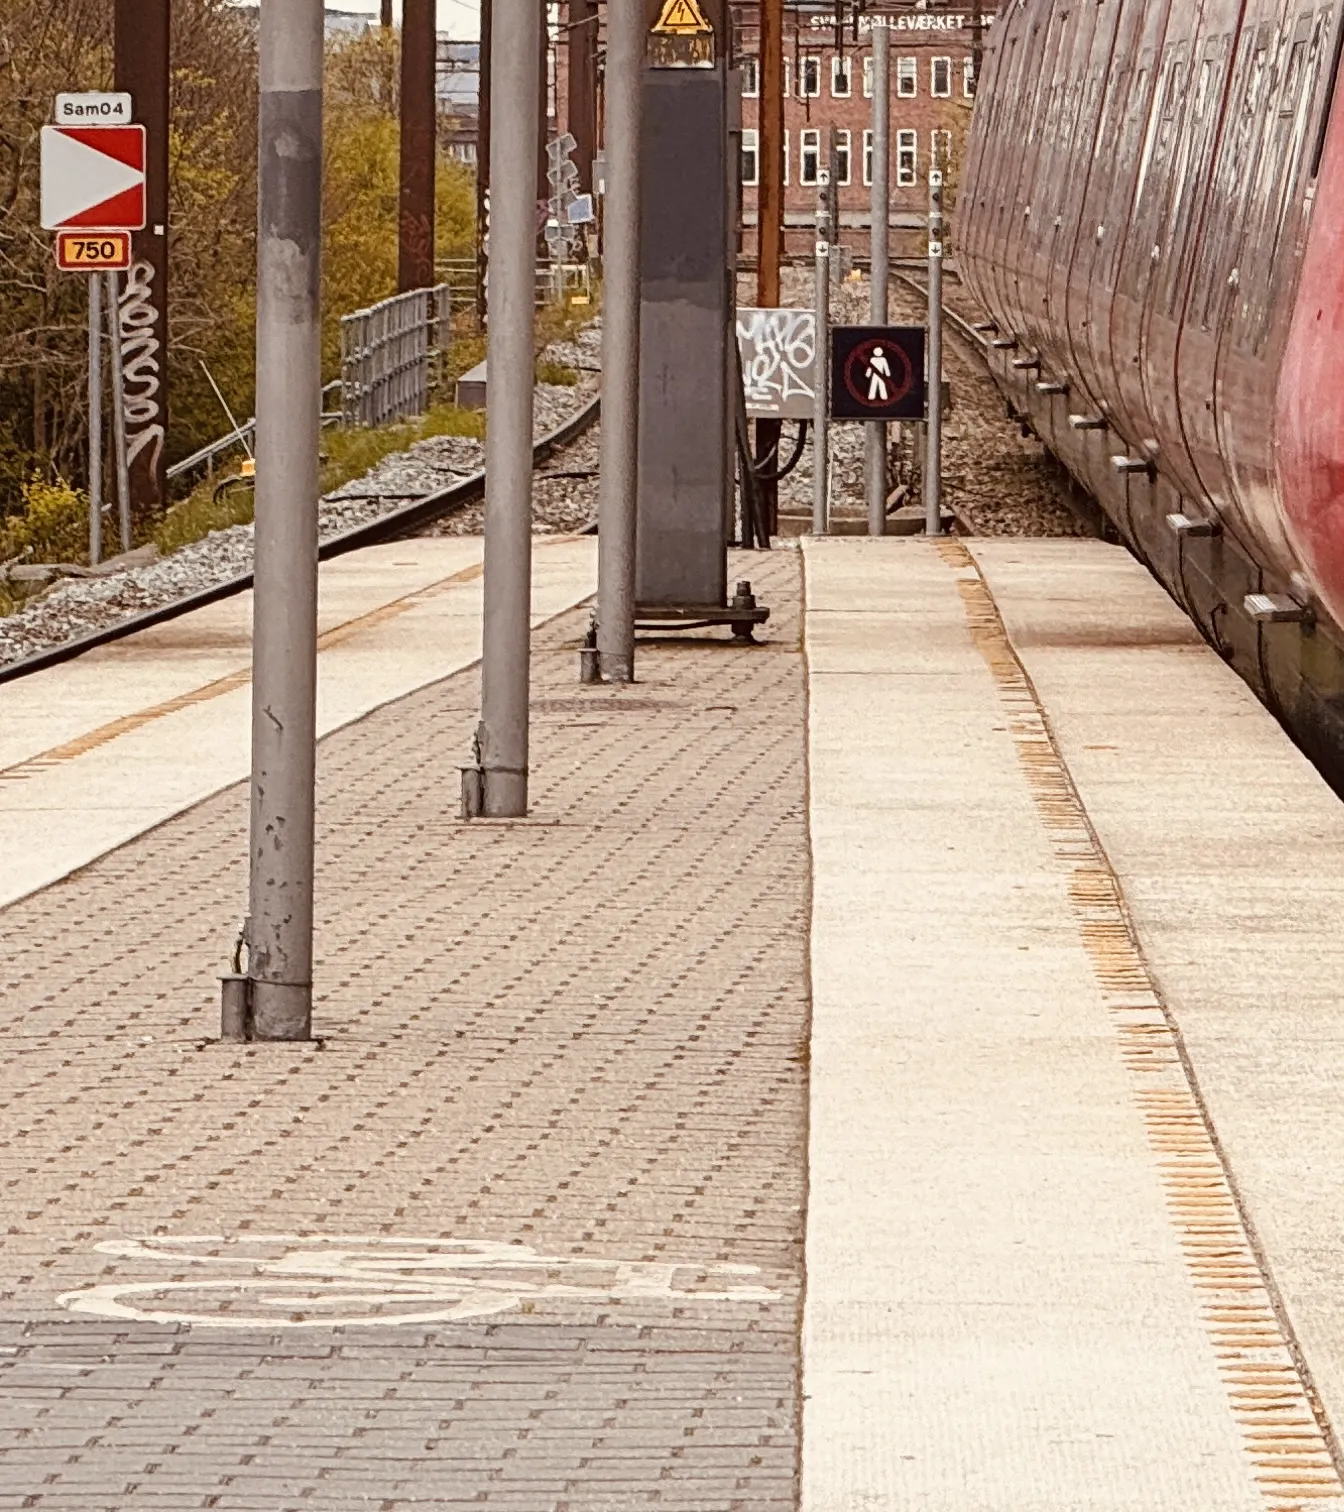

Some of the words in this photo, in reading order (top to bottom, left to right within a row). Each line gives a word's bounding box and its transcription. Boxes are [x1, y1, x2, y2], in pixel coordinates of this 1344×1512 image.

[811, 14, 965, 31] SVAMØLLEVÆRKET
[63, 102, 124, 116] Sam04
[72, 241, 115, 260] 750
